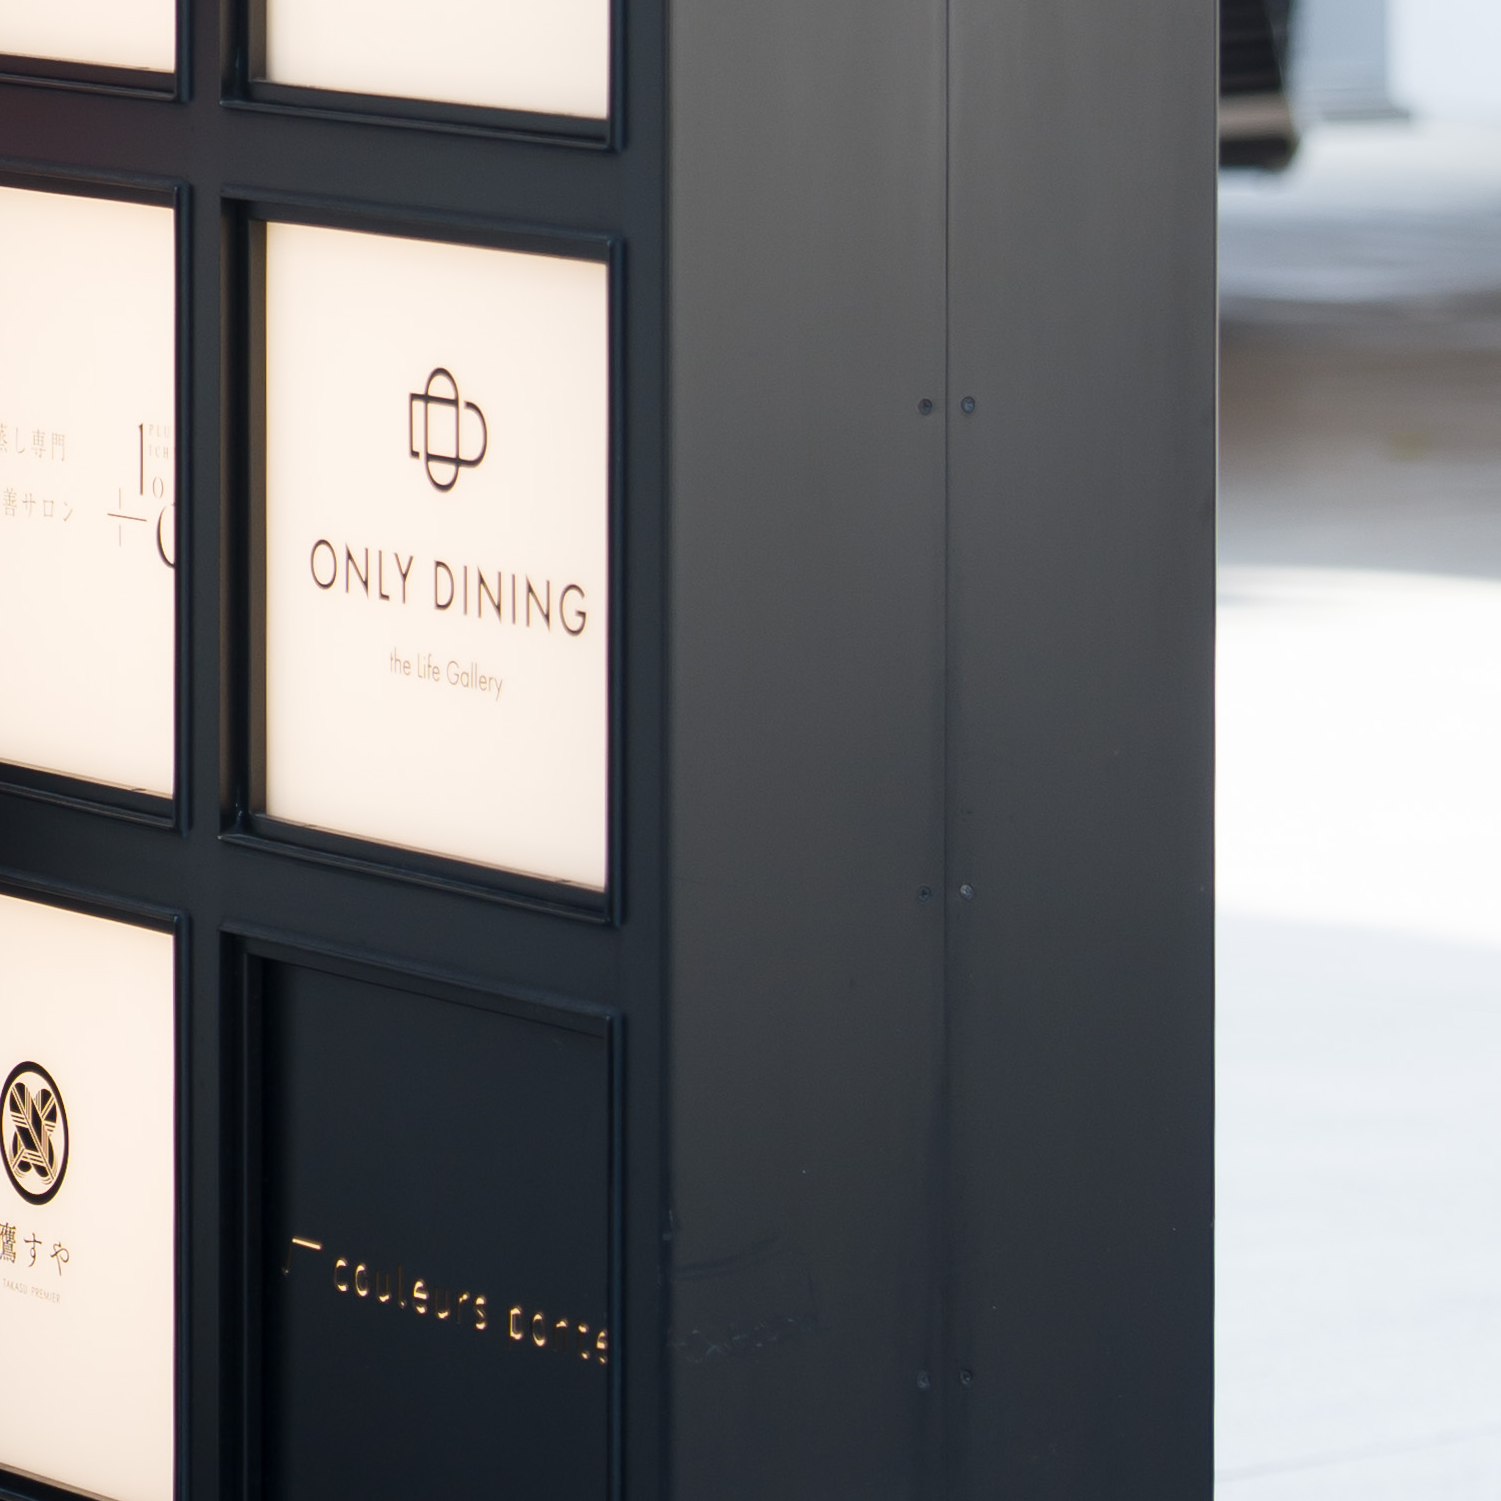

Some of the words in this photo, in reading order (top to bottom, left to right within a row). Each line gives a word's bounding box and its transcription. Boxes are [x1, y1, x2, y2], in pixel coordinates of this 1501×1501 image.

[310, 539, 414, 604] ONLY
[434, 560, 587, 636] DINING
[389, 648, 412, 676] the
[417, 653, 441, 682] Life
[446, 660, 504, 702] Gallery
[335, 1257, 488, 1331] couleurs
